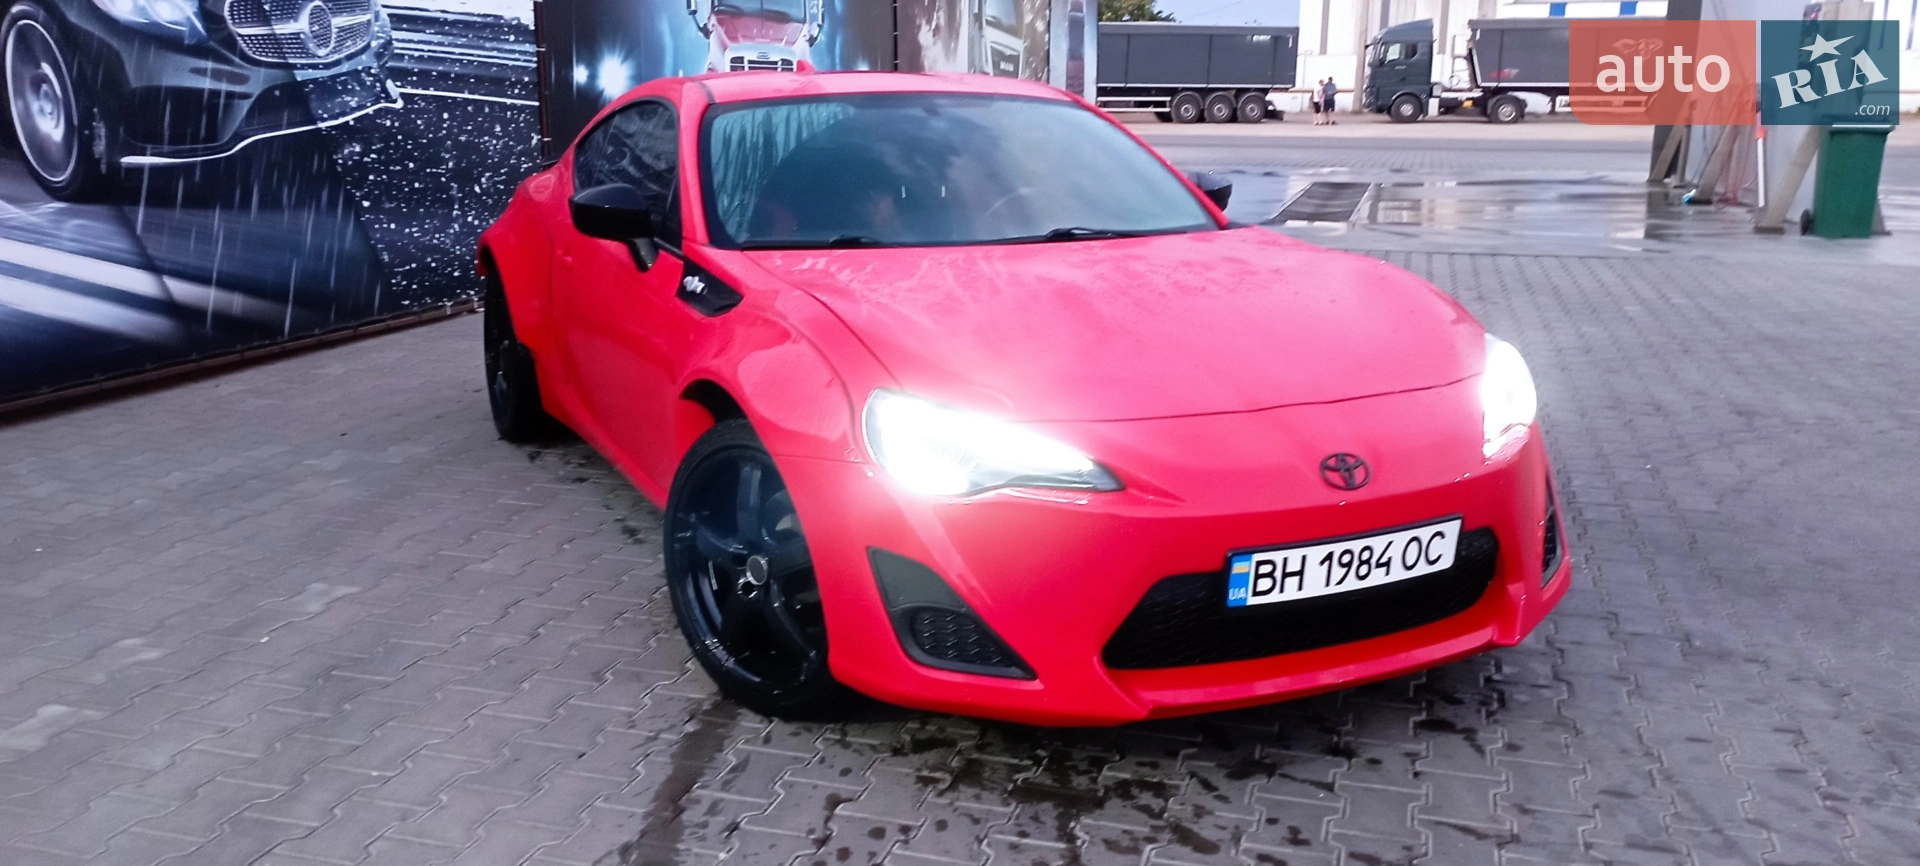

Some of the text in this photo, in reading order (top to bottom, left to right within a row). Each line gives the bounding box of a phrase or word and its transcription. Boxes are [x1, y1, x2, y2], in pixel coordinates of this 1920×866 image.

[1251, 531, 1446, 598] BH 1984 OC
[1229, 586, 1247, 601] UA
